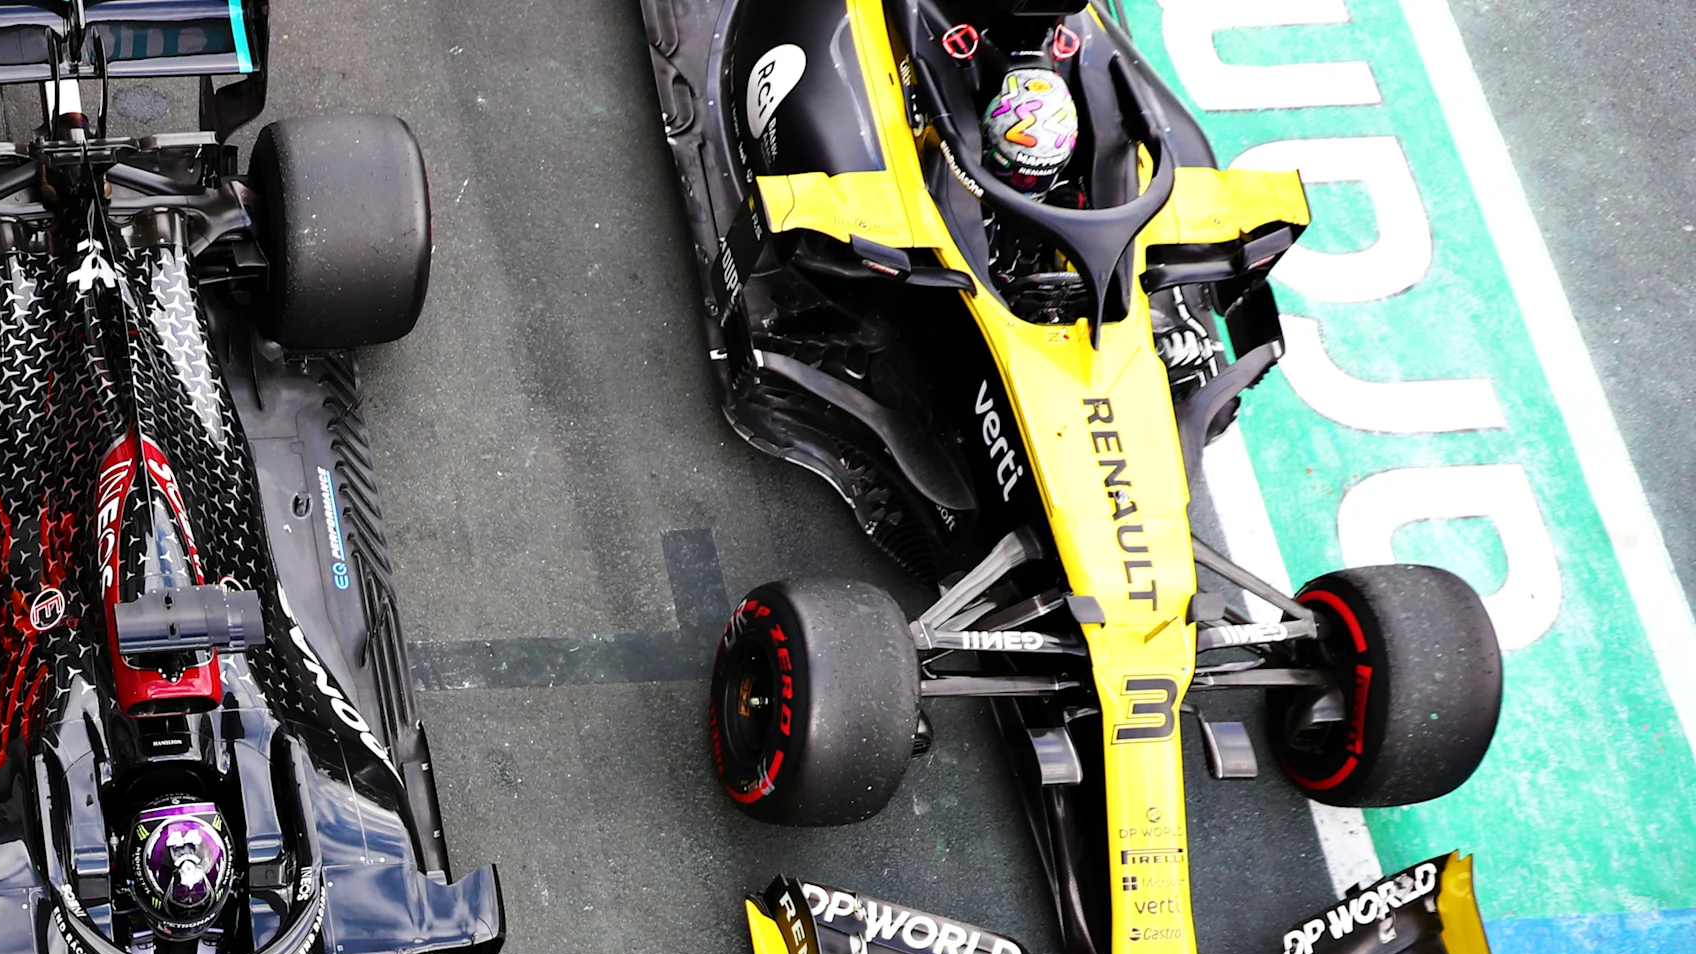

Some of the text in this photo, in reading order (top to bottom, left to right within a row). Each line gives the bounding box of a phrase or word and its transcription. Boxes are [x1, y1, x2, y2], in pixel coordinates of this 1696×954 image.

[975, 379, 1023, 502] verti
[98, 458, 133, 601] INEOS
[317, 466, 341, 560] PERFORMANCE
[1083, 398, 1158, 612] RENAULT
[769, 624, 793, 736] ZERO
[1110, 674, 1180, 746] 3
[1120, 847, 1185, 865] PIRELLI
[53, 906, 66, 932] END
[803, 883, 856, 924] DP
[1134, 896, 1181, 914] verti
[1327, 862, 1438, 940] WORLD
